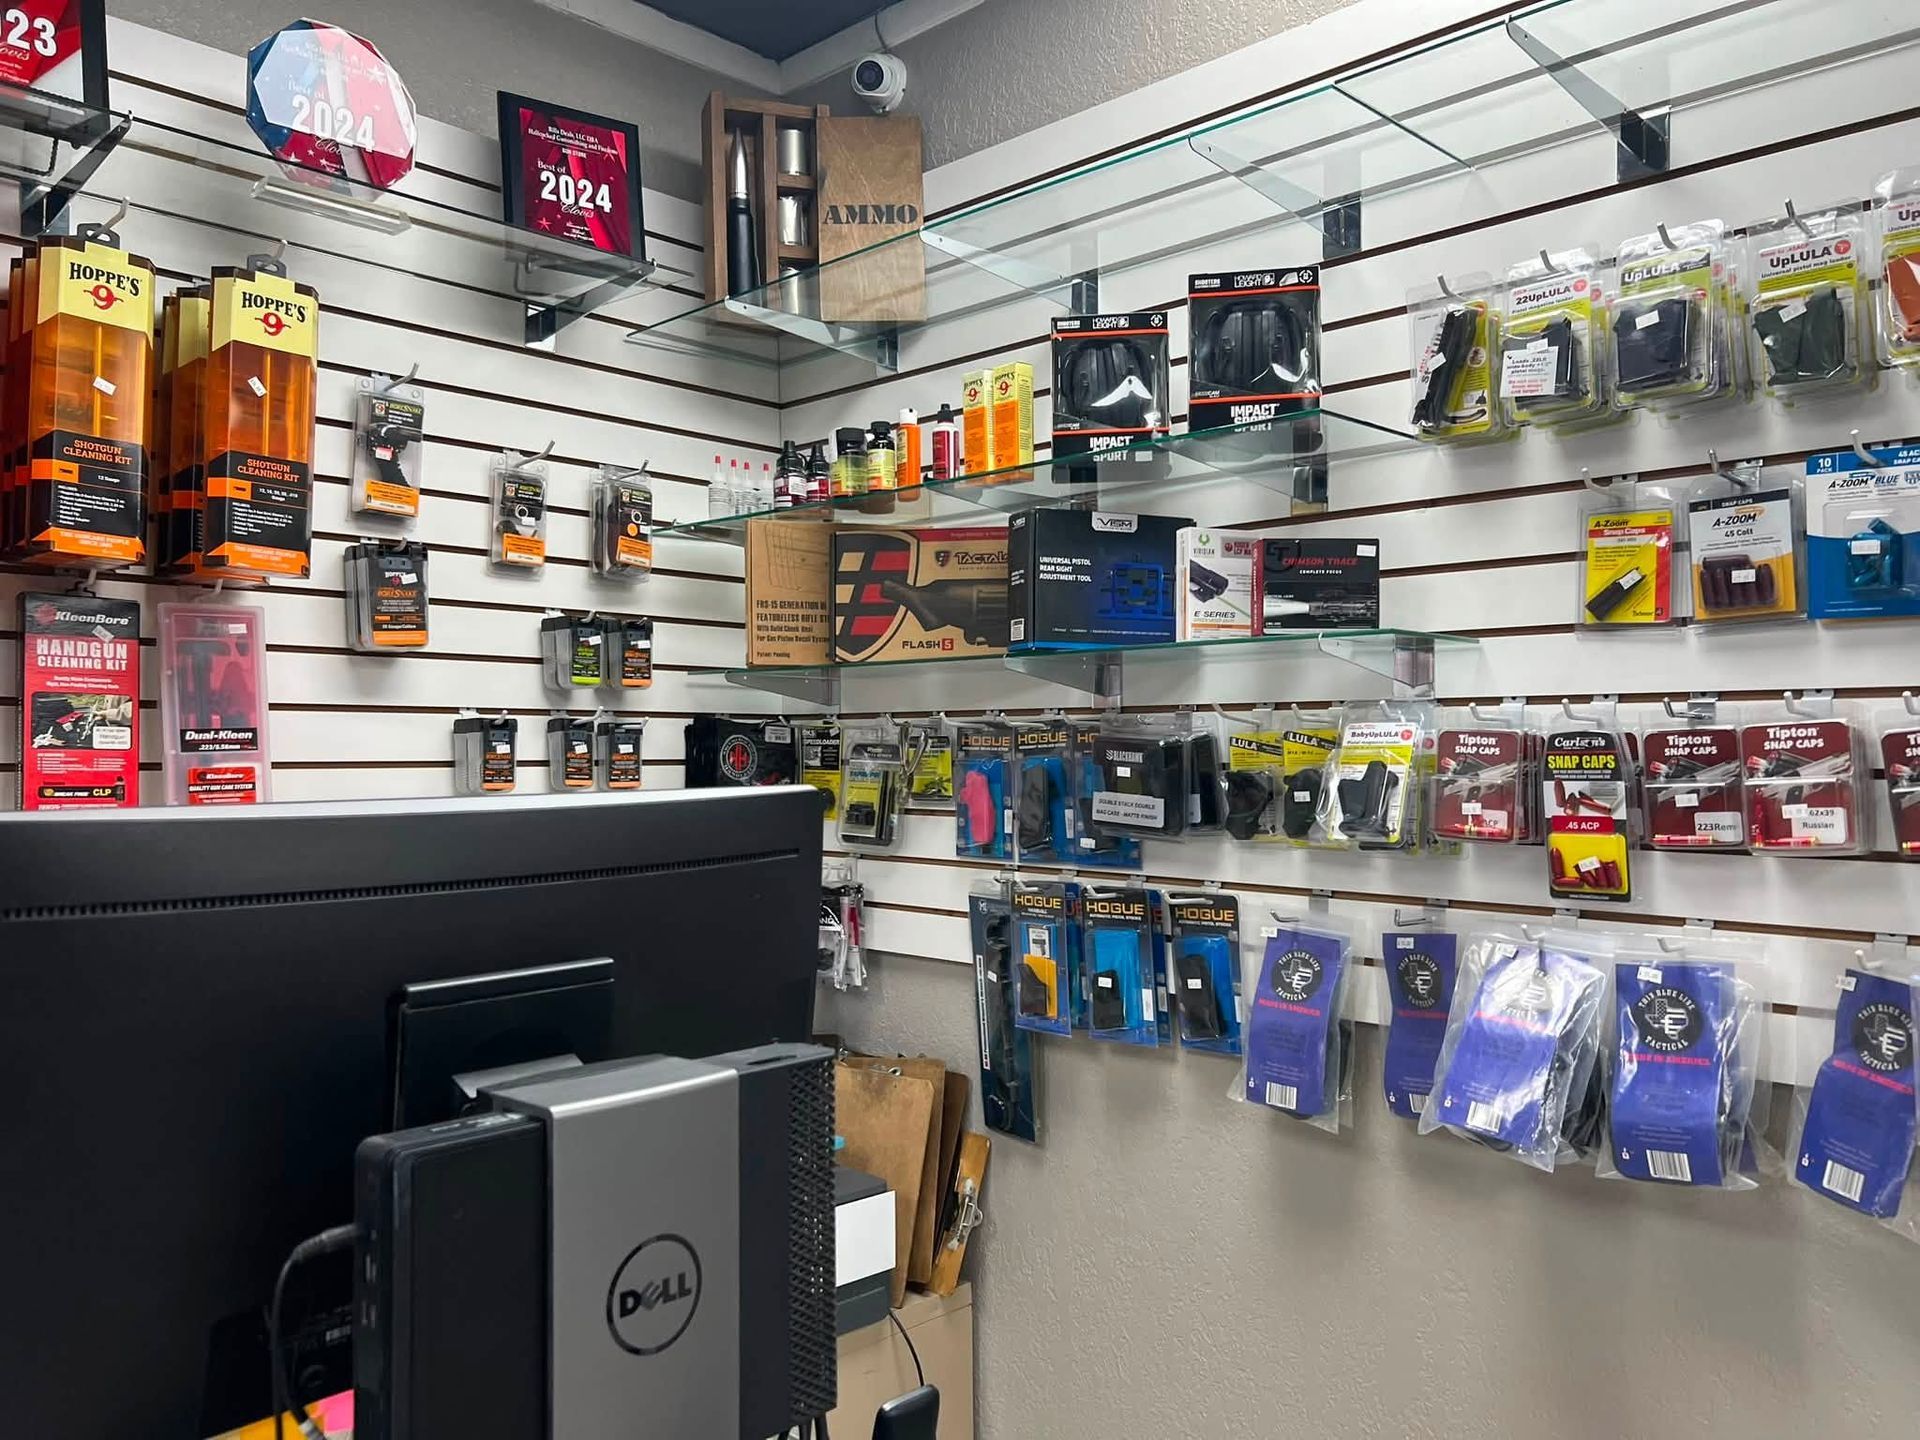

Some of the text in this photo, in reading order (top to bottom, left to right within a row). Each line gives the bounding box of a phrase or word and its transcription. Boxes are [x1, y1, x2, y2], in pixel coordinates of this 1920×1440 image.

[0, 9, 57, 57] 23
[292, 94, 376, 153] 2024
[537, 158, 567, 174] Best of
[539, 170, 613, 213] 2024
[822, 203, 919, 225] AMMO
[1769, 246, 1832, 269] UpLULA
[69, 262, 140, 297] HOPPE'S
[1624, 263, 1681, 283] UpLULA
[1515, 286, 1571, 306] 22UpLULA
[241, 291, 307, 324] HOPPE'S
[1231, 404, 1278, 418] IMPACT
[73, 439, 122, 455] SHOTGUN
[1090, 437, 1133, 449] IMPACT
[63, 446, 132, 465] CLEANING KIT
[1818, 457, 1832, 468] 10
[246, 458, 291, 473] SHOTGUN
[237, 465, 300, 483] CLEANING KIT
[1874, 474, 1901, 485] BLUE
[1828, 477, 1870, 490] A-ZOOM
[1096, 517, 1133, 528] VISM
[1594, 519, 1630, 528] A-Zoom
[1712, 513, 1757, 528] A-ZOOM
[1736, 528, 1754, 537] Colt
[1039, 556, 1092, 566] UNIVERSAL PISTOL
[1282, 557, 1360, 567] CRIMSON TRACE
[1039, 573, 1077, 582] ADJUSTMENT
[1194, 610, 1237, 619] E SERIES
[36, 639, 128, 660] HANDGUN
[902, 640, 940, 649] FLASH
[37, 656, 128, 671] CLEANING KIT
[185, 730, 253, 741] Dual-Kleen
[1017, 731, 1068, 745] HOGUE
[1288, 732, 1319, 746] LULA
[1350, 731, 1399, 739] BabyUpLULA
[1458, 734, 1497, 746] Tipton
[1767, 727, 1817, 739] Tipton
[961, 735, 1010, 747] HOGUE
[1231, 737, 1258, 750] LULA
[1554, 737, 1606, 749] Carlson's
[1666, 735, 1707, 747] Tipton
[1763, 738, 1824, 750] SNAP CAPS
[1454, 746, 1500, 755] SNAP CAPS
[1664, 746, 1718, 757] SNAP CAPS
[1905, 748, 1920, 758] SN
[1548, 754, 1615, 770] SNAP CAPS
[93, 788, 112, 797] CLP
[1565, 821, 1600, 831] .45 ACP
[1802, 821, 1835, 830] Russian
[1014, 894, 1062, 909] HOGUE
[1086, 901, 1145, 916] HOGUE
[1174, 906, 1236, 922] HOGUE
[1275, 986, 1308, 1001] TACTICAL
[1638, 988, 1697, 1011] THIN BLUE LINE
[1878, 1003, 1899, 1018] BLUE
[1644, 1034, 1689, 1051] TACTICAL
[1861, 1050, 1900, 1072] TACTICAL
[619, 1271, 692, 1319] DELL
